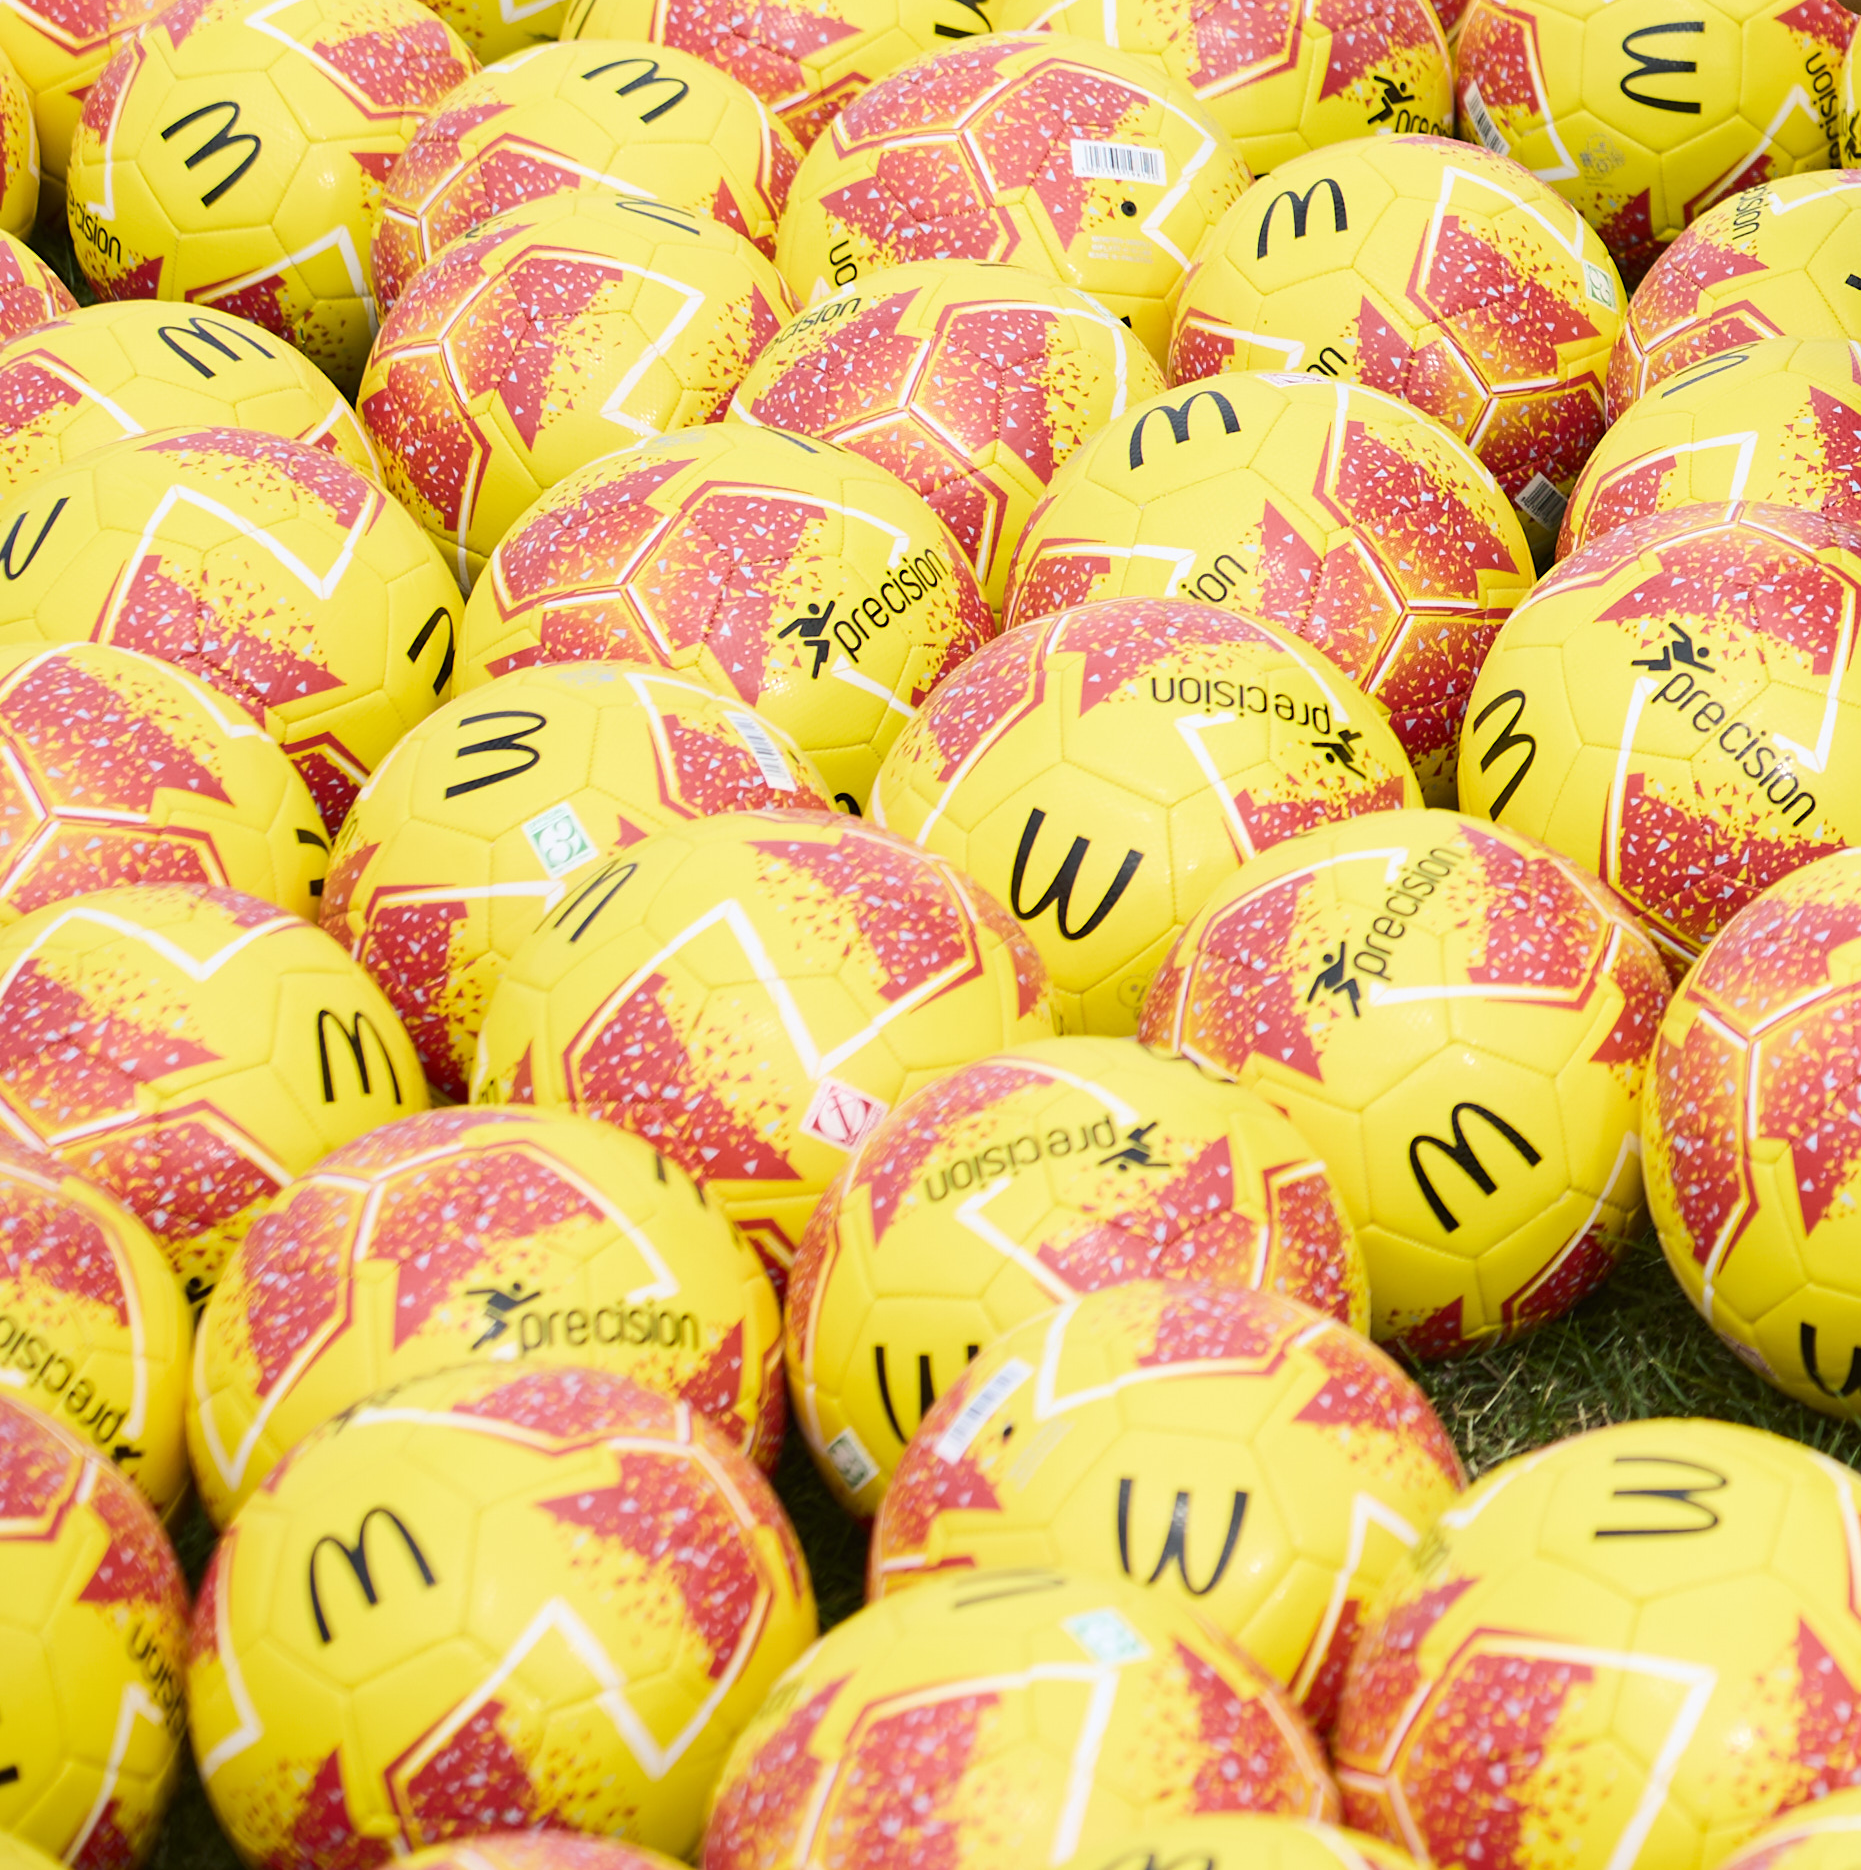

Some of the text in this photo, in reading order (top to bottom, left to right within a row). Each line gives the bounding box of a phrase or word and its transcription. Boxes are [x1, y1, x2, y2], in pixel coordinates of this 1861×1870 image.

[582, 59, 688, 123] M
[1620, 22, 1704, 114] M
[161, 101, 261, 207] M
[1257, 179, 1347, 259] M
[158, 318, 275, 378] M
[1130, 391, 1240, 470] M
[834, 546, 946, 662] precision
[1150, 673, 1333, 733] precision
[1652, 669, 1819, 827] precision
[446, 711, 546, 799] M
[1474, 690, 1536, 822] M
[1011, 808, 1142, 940] M
[1354, 841, 1463, 982] precision
[318, 1005, 405, 1105] M
[921, 1114, 1119, 1206] precision
[1409, 1103, 1542, 1233] M
[517, 1298, 704, 1356] precision
[1118, 1479, 1247, 1595] M
[1593, 1455, 1729, 1543] M
[309, 1509, 435, 1644] M
